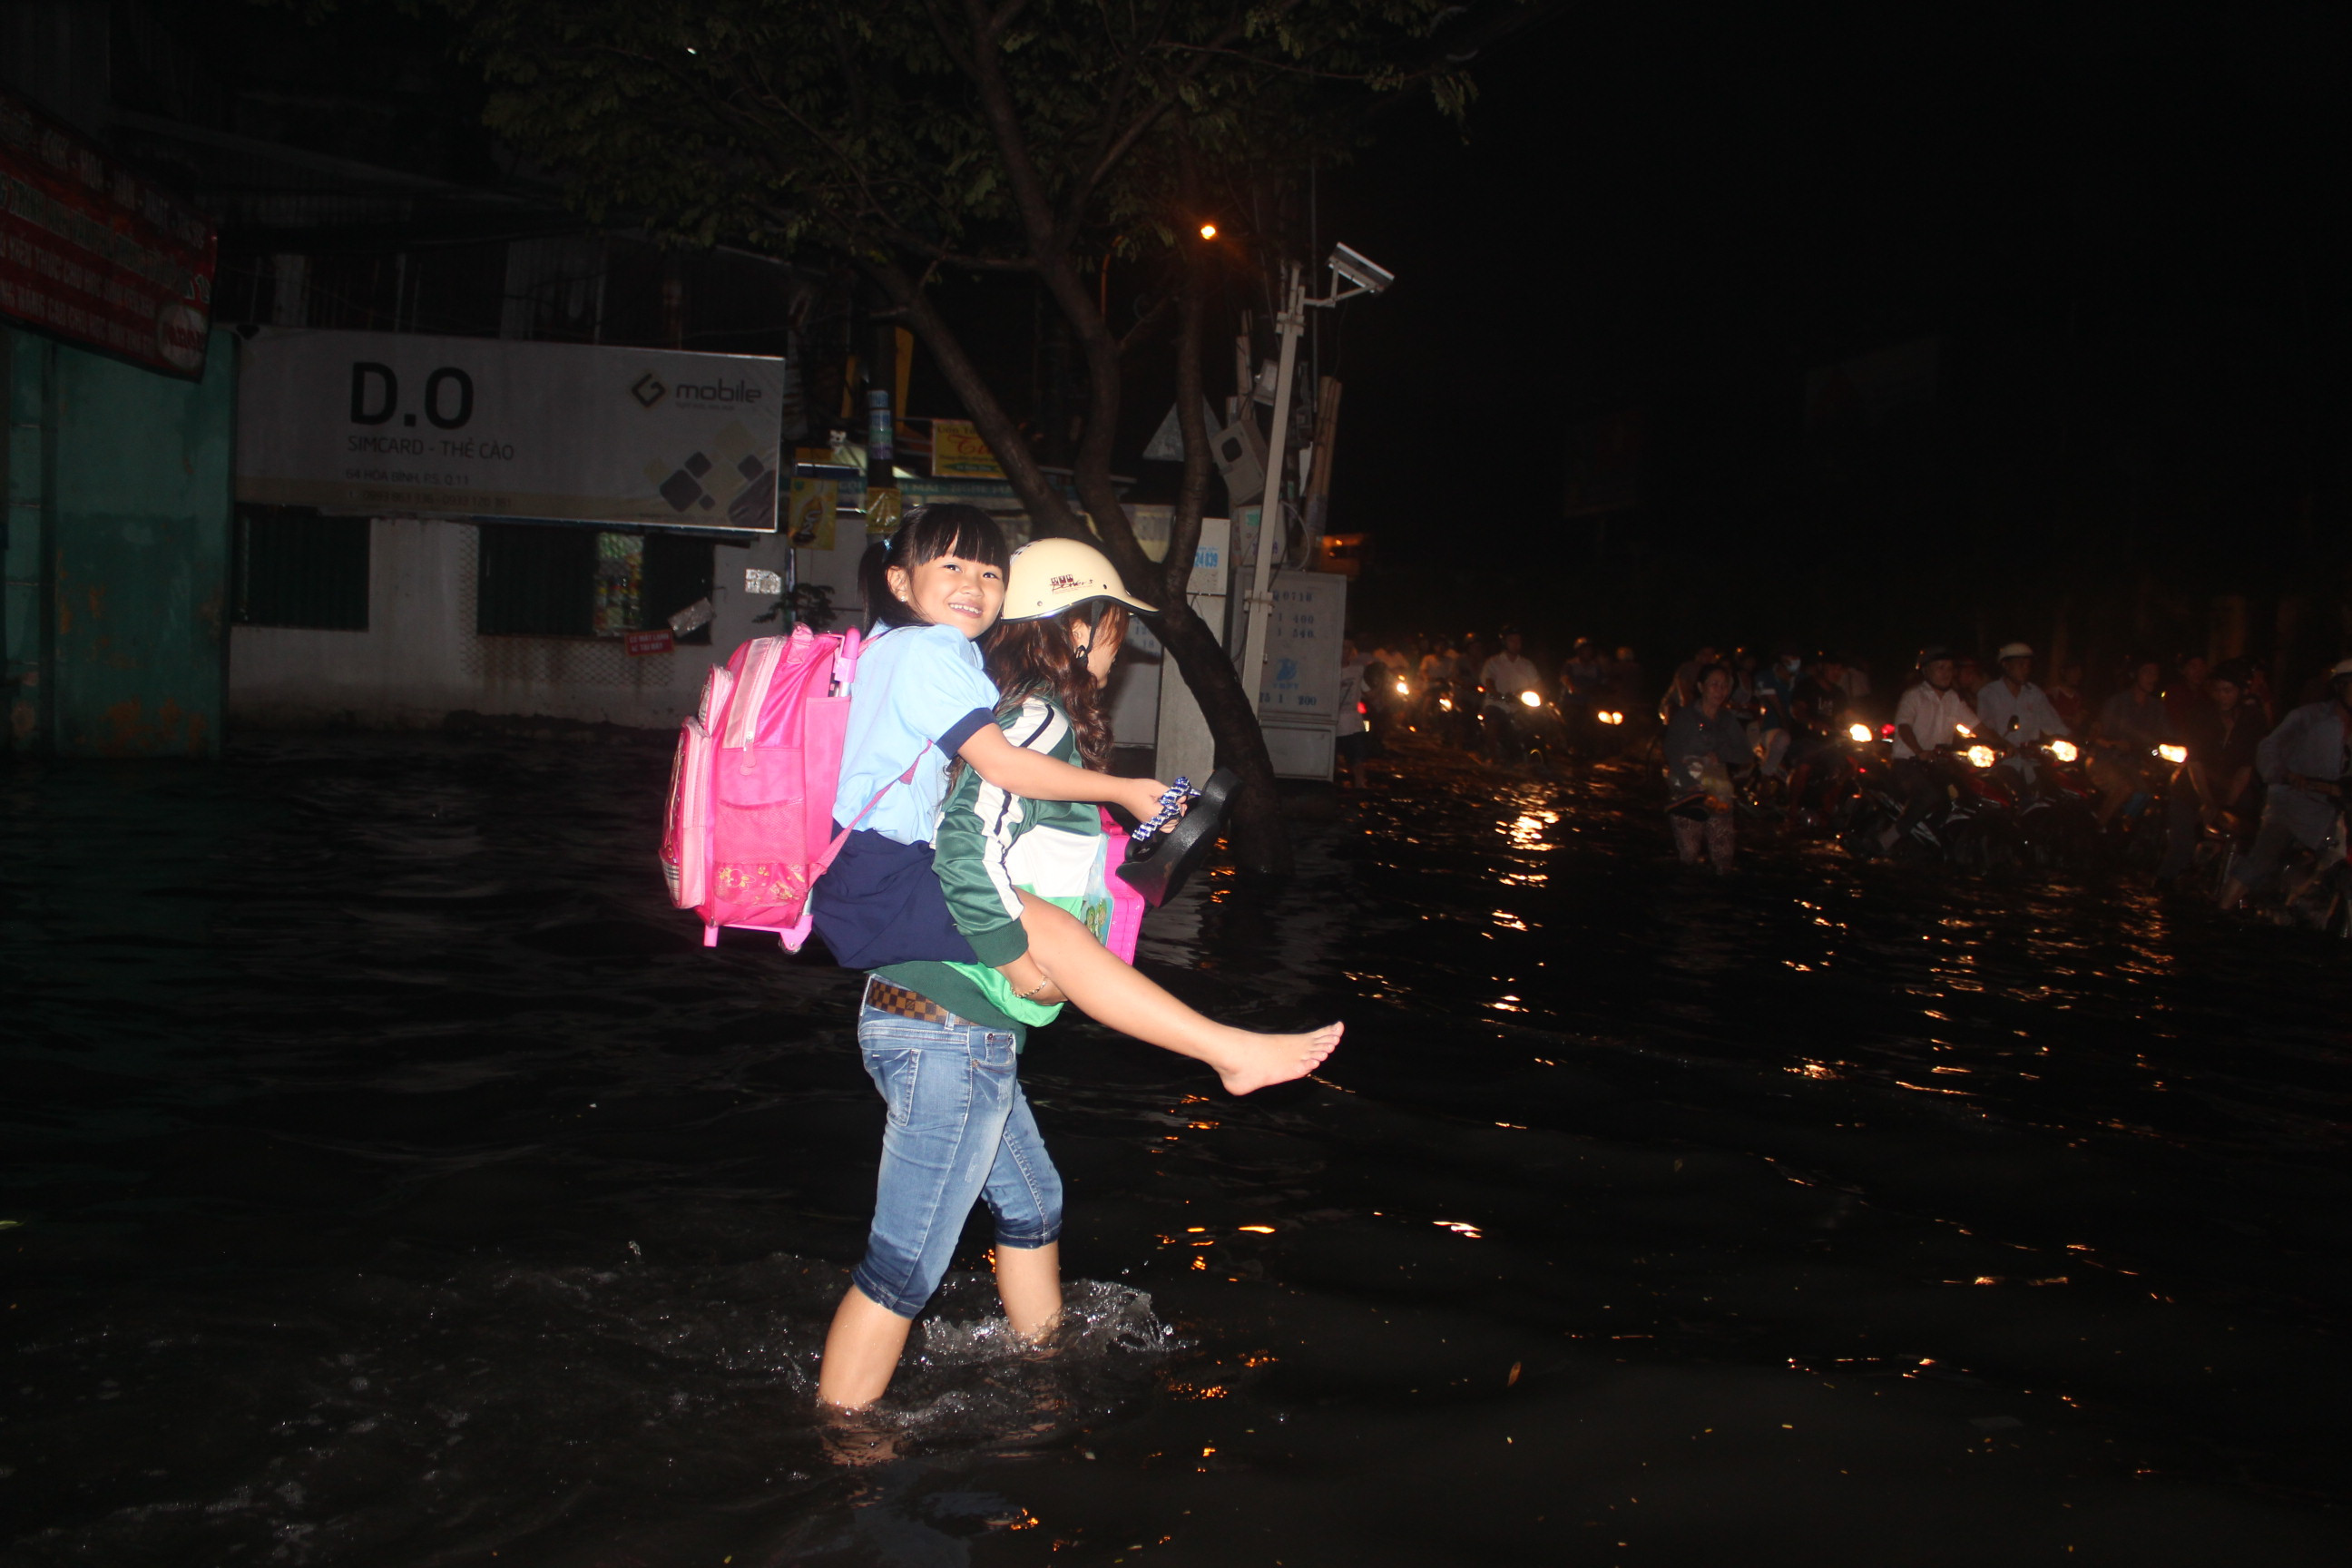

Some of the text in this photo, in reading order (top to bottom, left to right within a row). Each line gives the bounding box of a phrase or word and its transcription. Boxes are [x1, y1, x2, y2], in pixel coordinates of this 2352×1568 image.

[350, 361, 474, 430] D.O
[676, 378, 762, 404] mobile
[347, 435, 425, 456] SIMCARD
[440, 436, 475, 459] THẺ
[478, 439, 514, 461] CÀO
